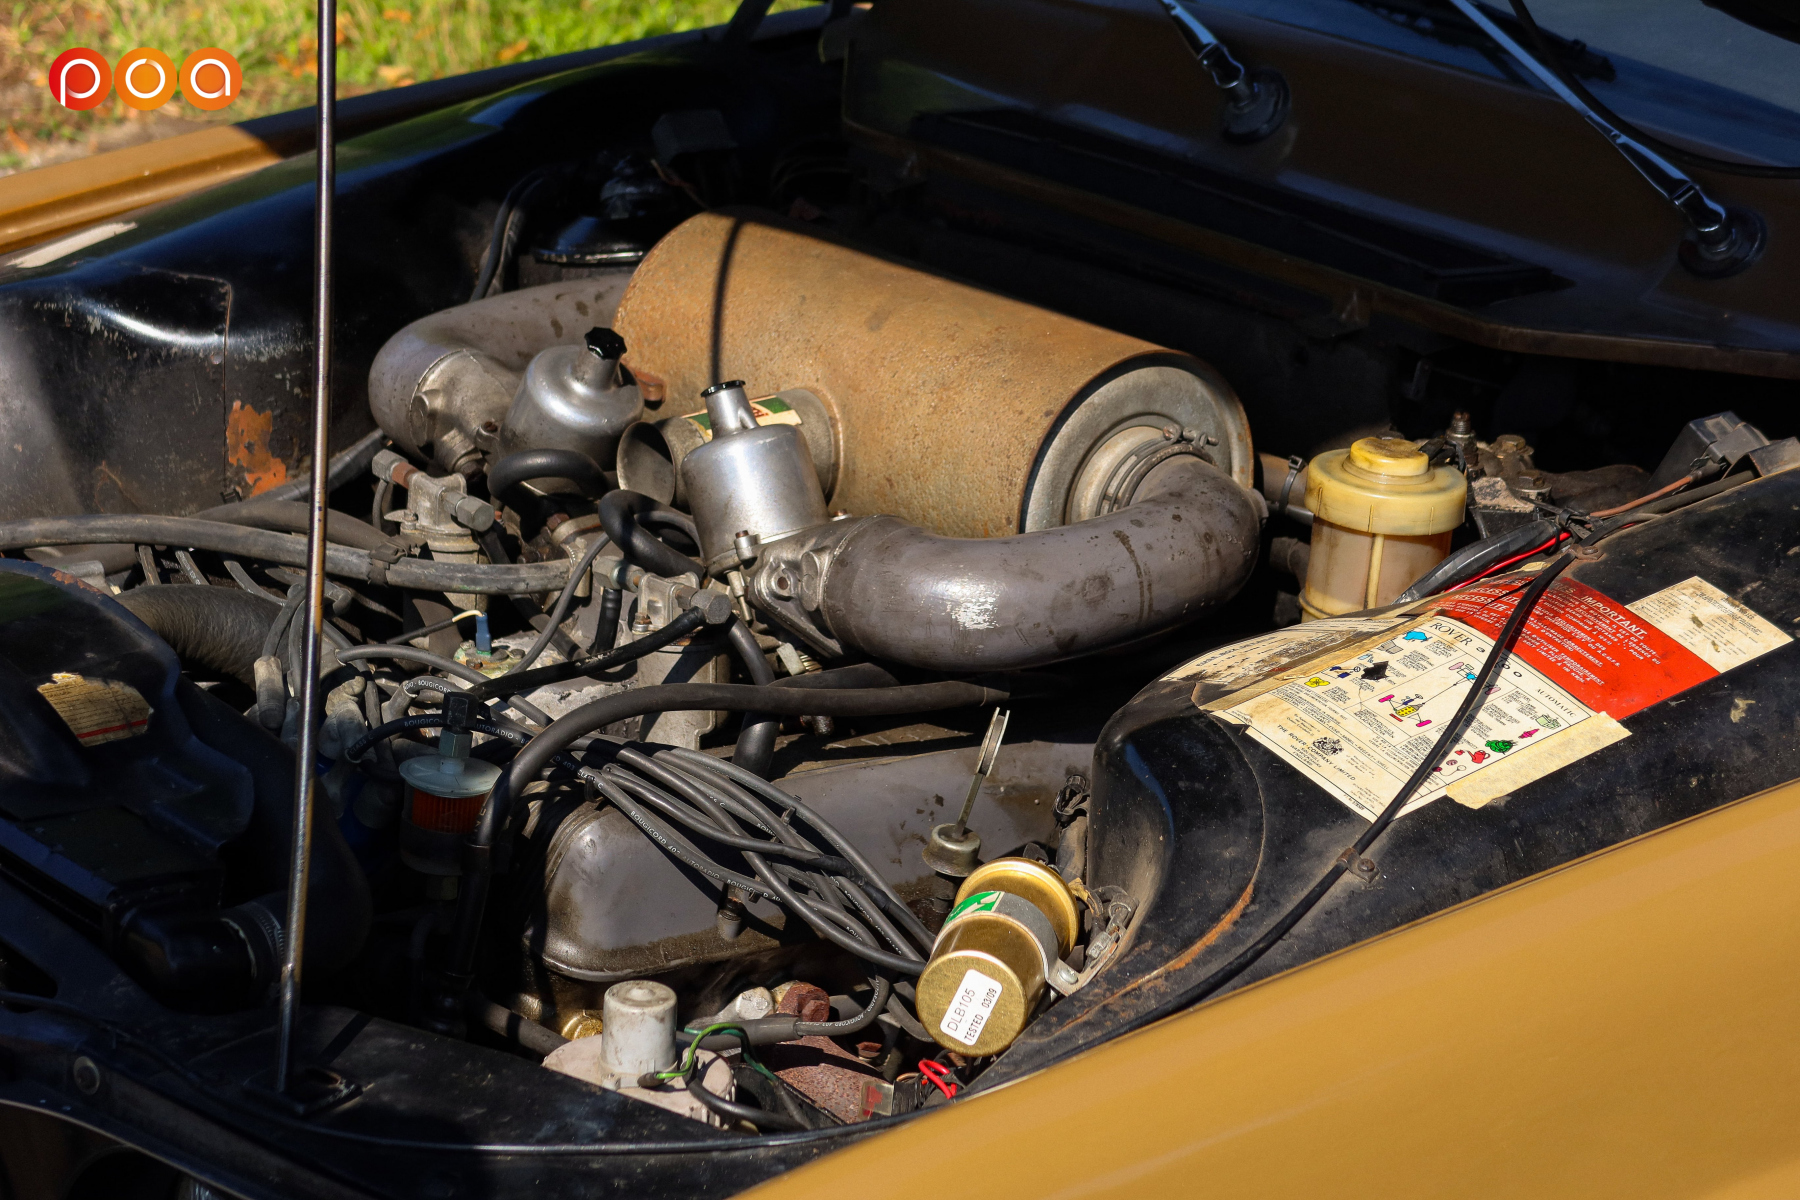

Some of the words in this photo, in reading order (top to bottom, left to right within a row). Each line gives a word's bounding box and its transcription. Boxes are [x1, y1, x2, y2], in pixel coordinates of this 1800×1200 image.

[1429, 621, 1473, 646] ROVER
[1287, 733, 1307, 745] ROVER
[1307, 746, 1333, 764] COMPANY
[1333, 765, 1355, 780] LIMITED
[630, 810, 667, 845] BOUGICORD
[946, 988, 976, 1032] DLB105
[964, 1014, 984, 1042] TESTED
[982, 988, 996, 1008] 03/09
